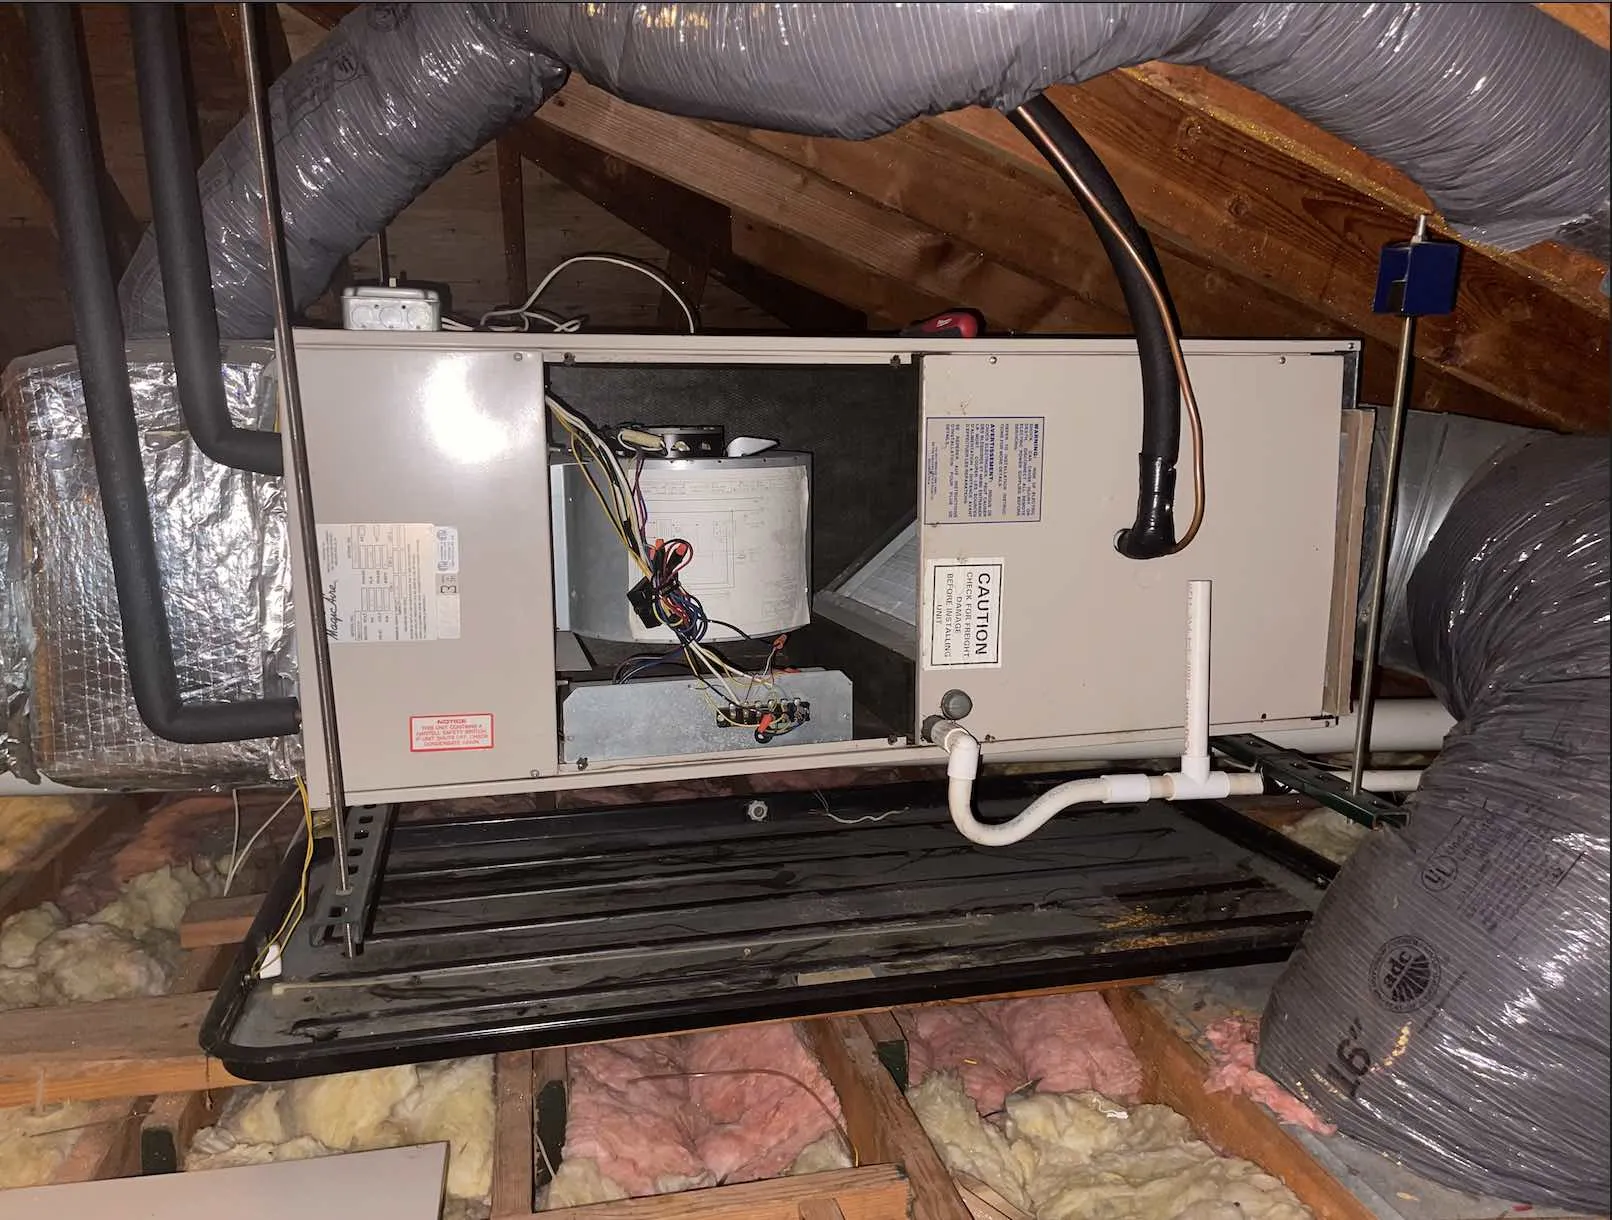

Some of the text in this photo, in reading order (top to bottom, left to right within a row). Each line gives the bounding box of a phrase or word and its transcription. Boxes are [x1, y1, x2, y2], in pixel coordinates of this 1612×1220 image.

[966, 572, 974, 600] CHECK
[936, 604, 944, 625] UNIT
[944, 574, 954, 658] BEFORE INSTALLING
[954, 596, 963, 634] DAMAGE
[976, 572, 991, 654] CAUTION
[964, 622, 972, 658] FREIGHT
